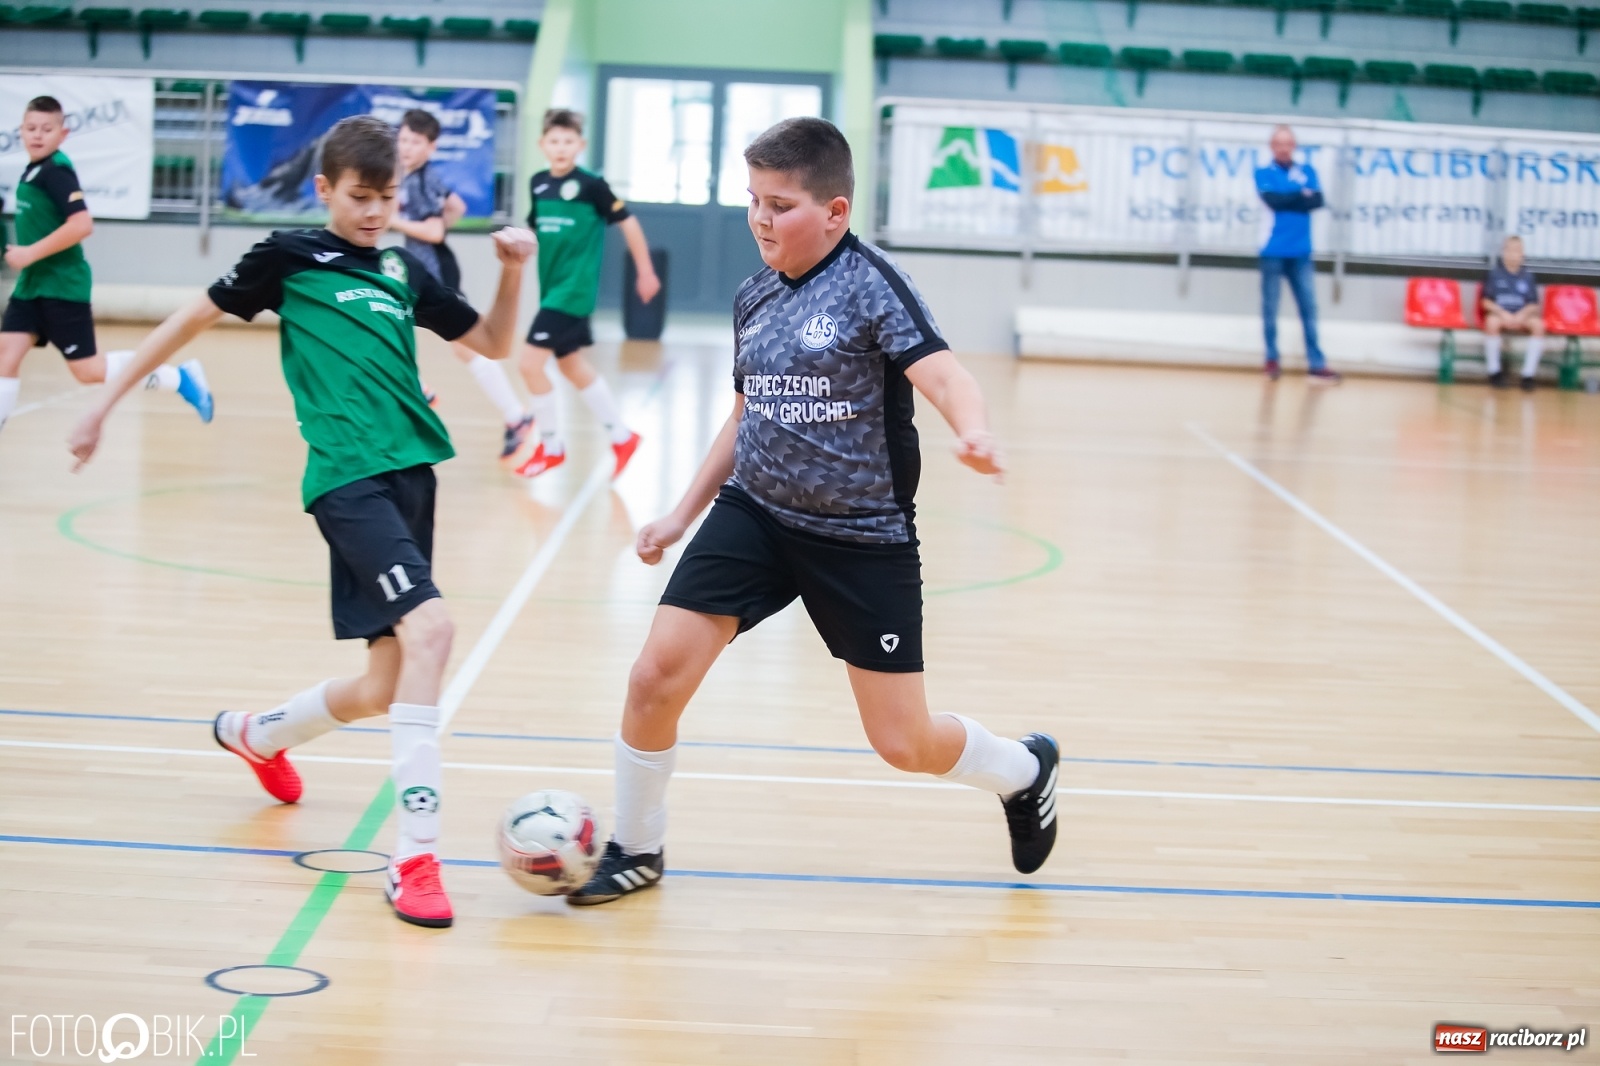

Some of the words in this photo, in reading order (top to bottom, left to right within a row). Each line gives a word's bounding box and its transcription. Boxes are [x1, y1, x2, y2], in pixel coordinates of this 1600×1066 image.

[1132, 145, 1321, 178] POWIT
[806, 316, 833, 338] LKS
[780, 401, 857, 423] GRUCHEL
[375, 564, 417, 602] 11
